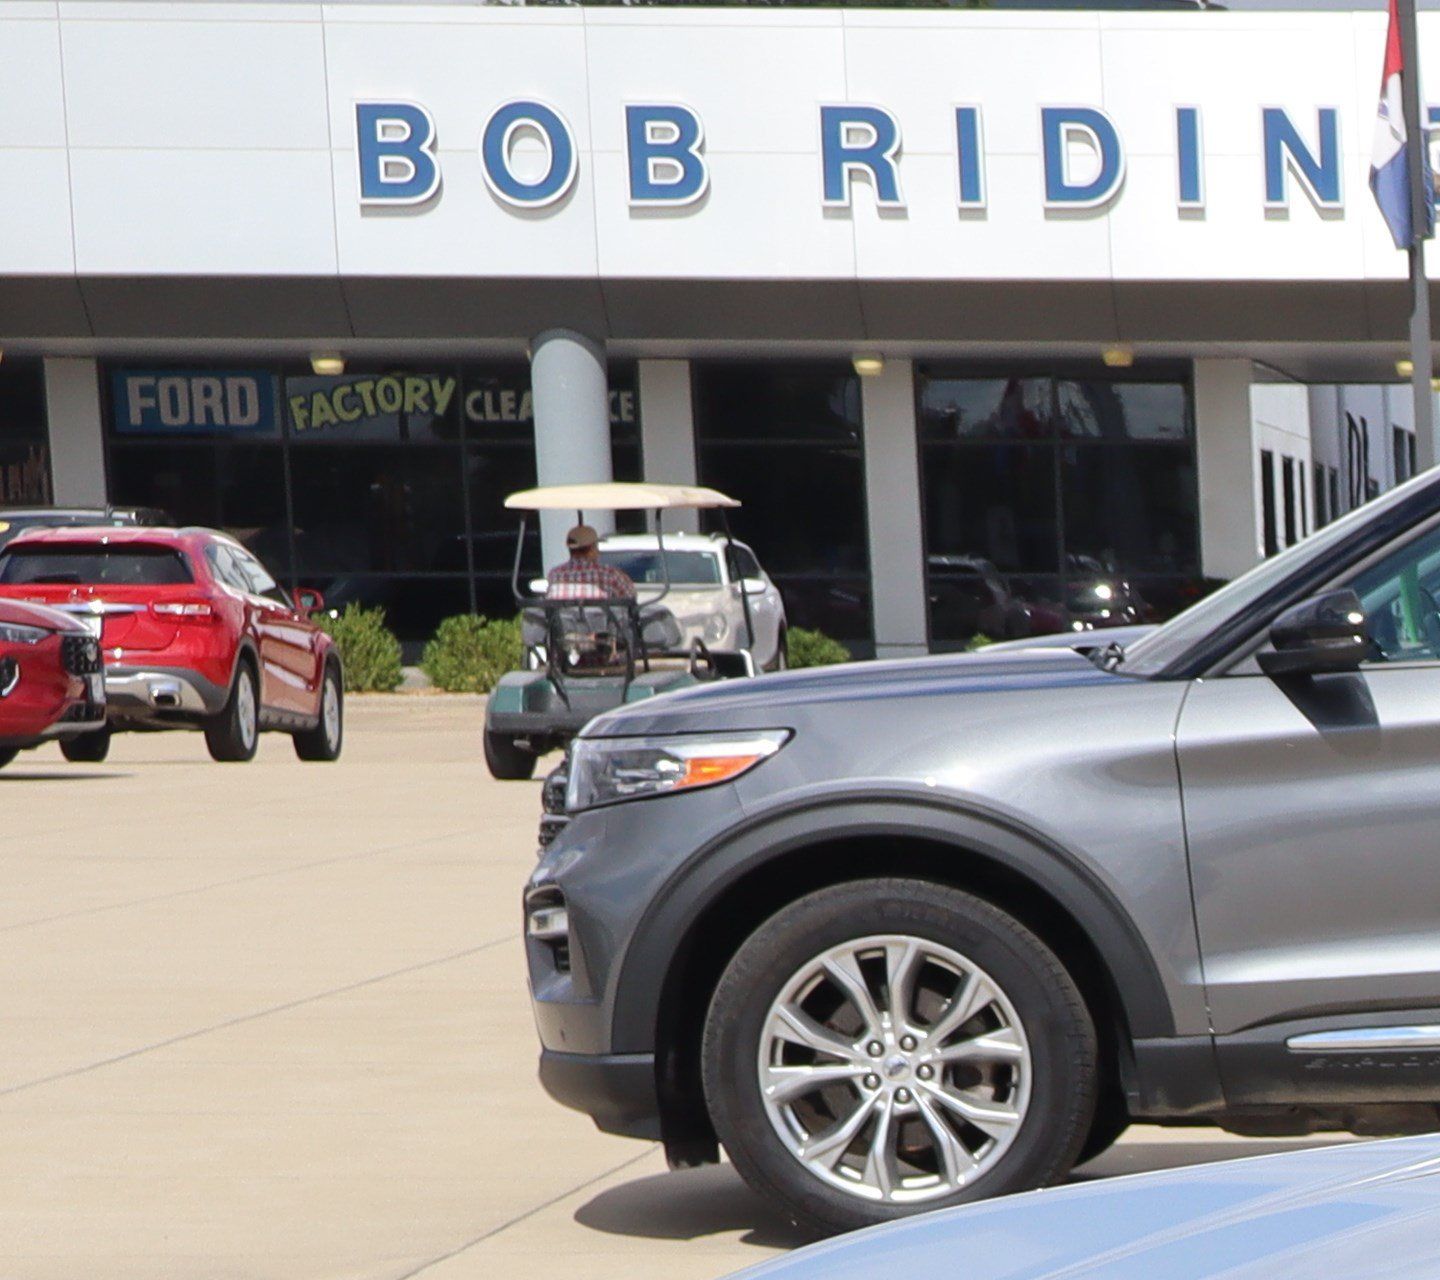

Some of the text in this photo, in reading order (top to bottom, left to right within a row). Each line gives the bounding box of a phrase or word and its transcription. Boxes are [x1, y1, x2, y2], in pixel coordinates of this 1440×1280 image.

[356, 98, 712, 212] BOB
[125, 375, 261, 428] FORD
[288, 374, 457, 434] FACTORY
